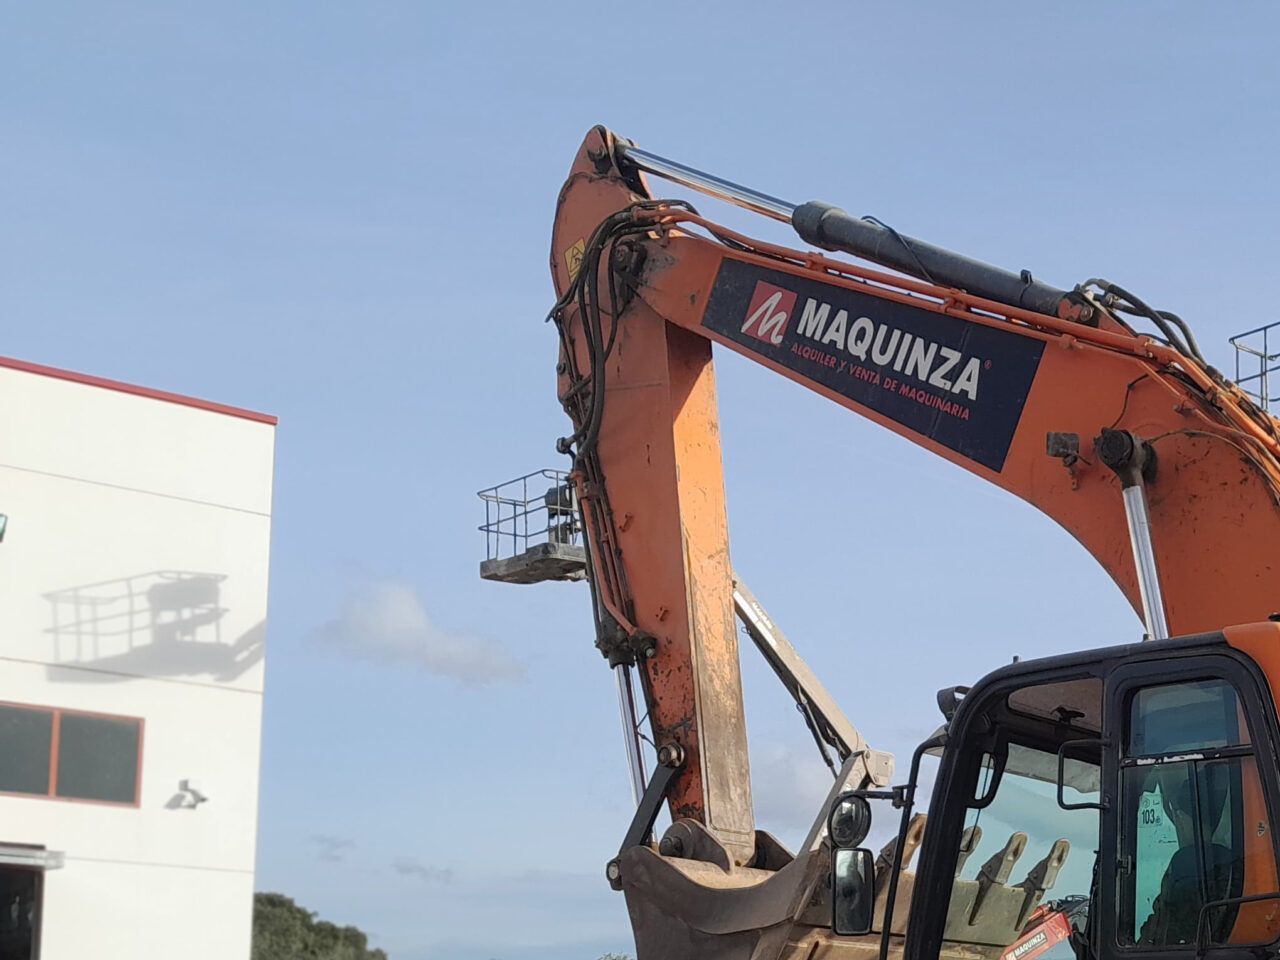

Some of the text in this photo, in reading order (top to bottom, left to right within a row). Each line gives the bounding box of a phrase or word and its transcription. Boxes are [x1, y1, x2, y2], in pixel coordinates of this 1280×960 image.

[797, 297, 982, 401] MAQUINZA
[791, 342, 971, 421] ALQUILER Y VENTA DE MAQUINARIA
[1141, 808, 1155, 825] 103
[1014, 932, 1046, 957] MAQUINZA
